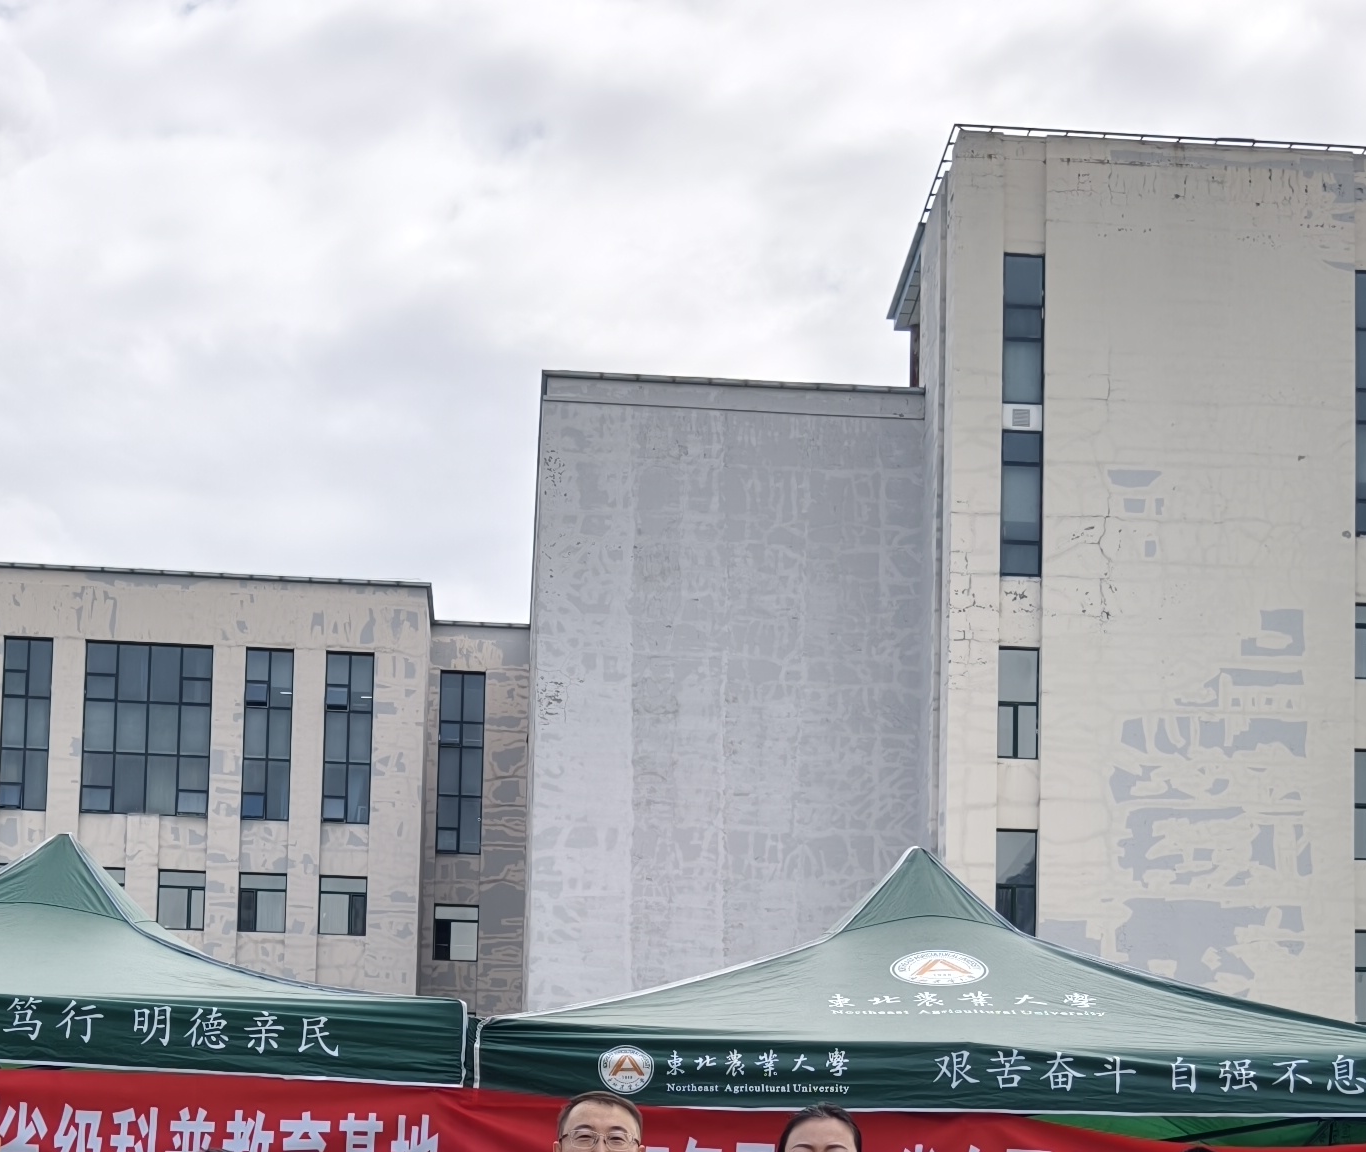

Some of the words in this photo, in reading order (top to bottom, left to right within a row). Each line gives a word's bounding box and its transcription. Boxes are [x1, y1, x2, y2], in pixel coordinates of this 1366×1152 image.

[132, 1005, 340, 1057] 明德亲民
[666, 1083, 719, 1093] Northeast
[724, 1083, 790, 1094] Agricultural
[793, 1083, 850, 1095] University
[932, 1048, 1137, 1094] 艰苦奋斗
